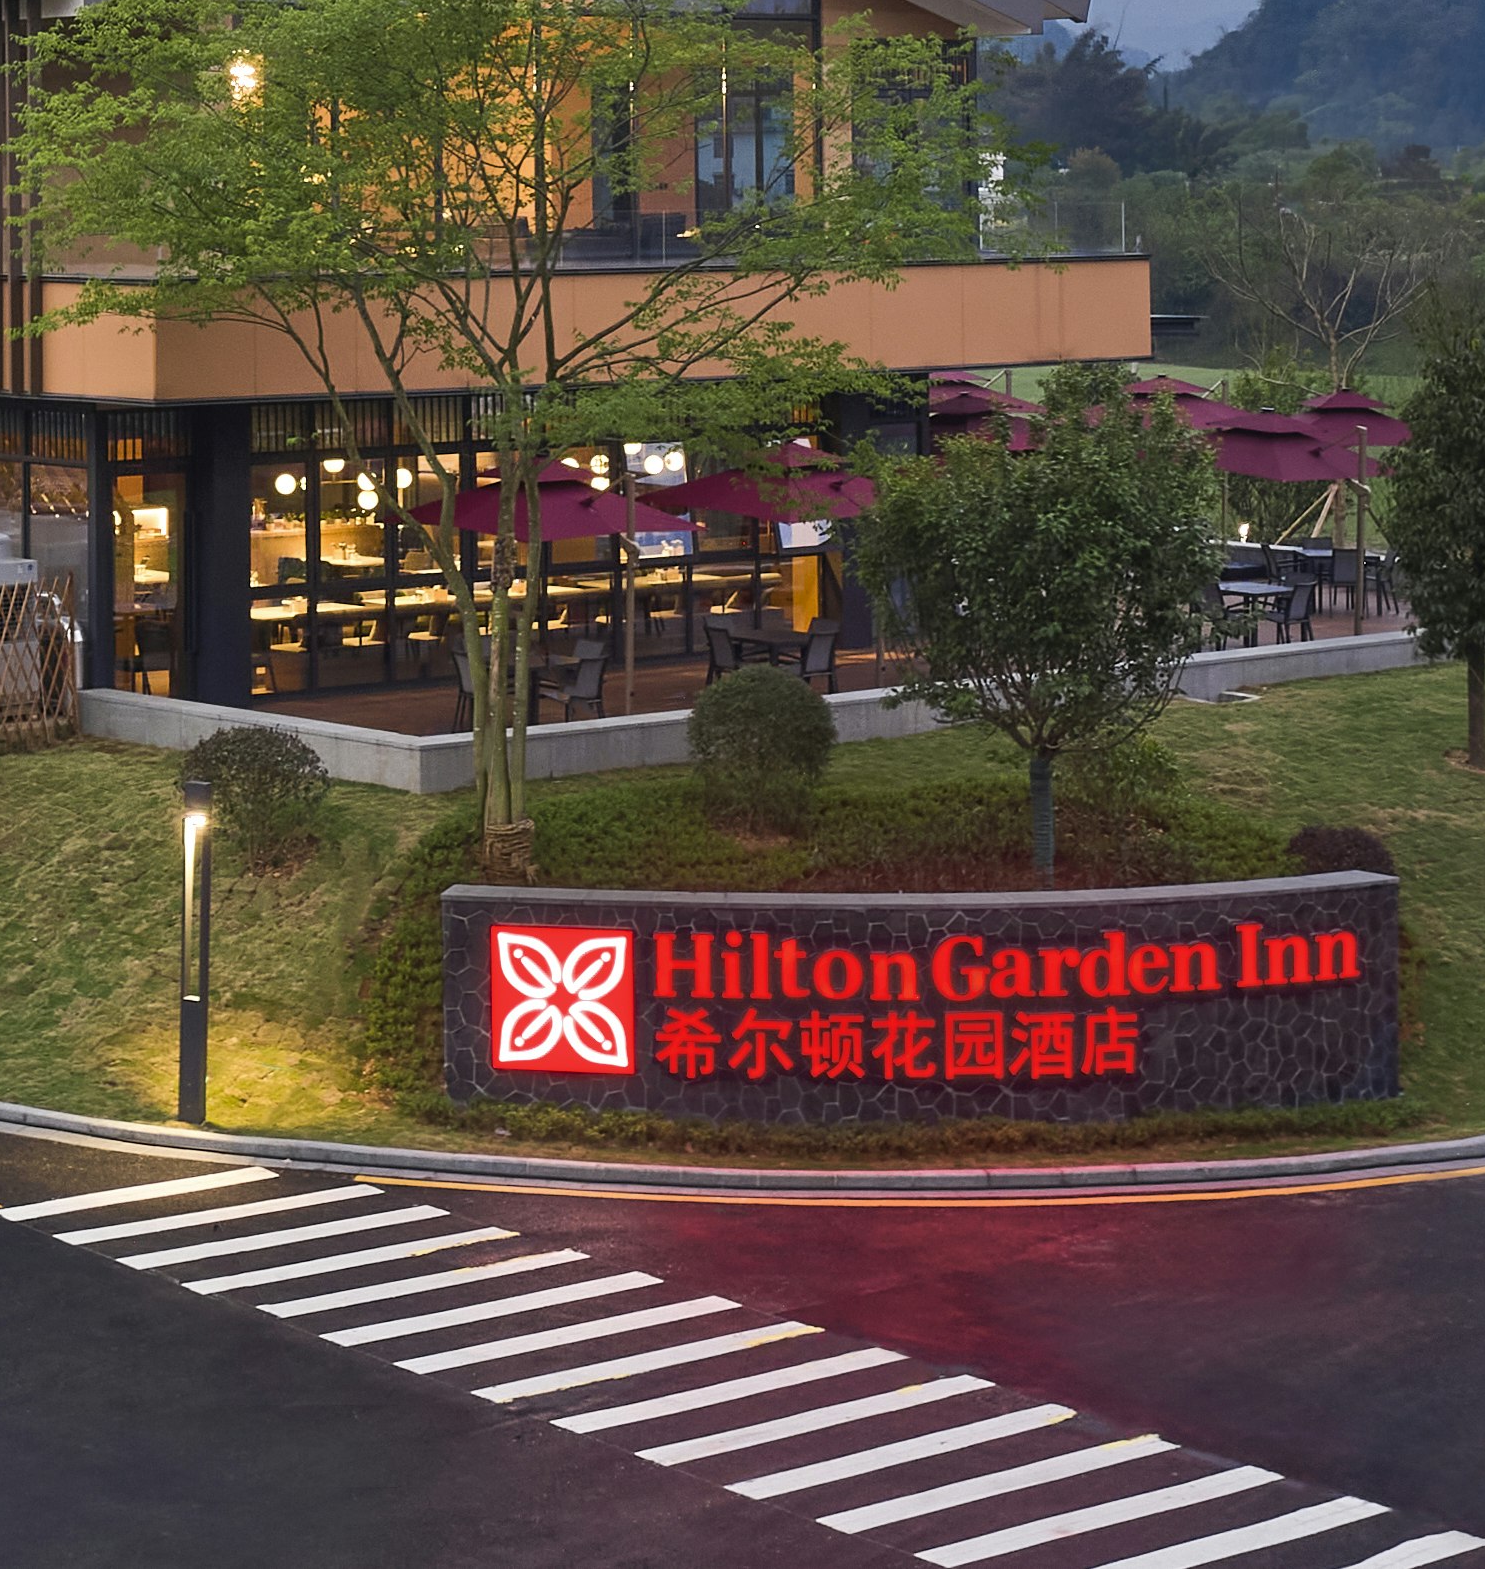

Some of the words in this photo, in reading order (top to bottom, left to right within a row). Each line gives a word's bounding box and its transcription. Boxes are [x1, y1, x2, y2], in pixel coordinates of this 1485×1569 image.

[653, 930, 921, 1001] Hilton
[931, 929, 1222, 1001] Garden
[1234, 922, 1361, 988] Inn
[654, 1006, 1139, 1080] 希尔顿花园酒店
